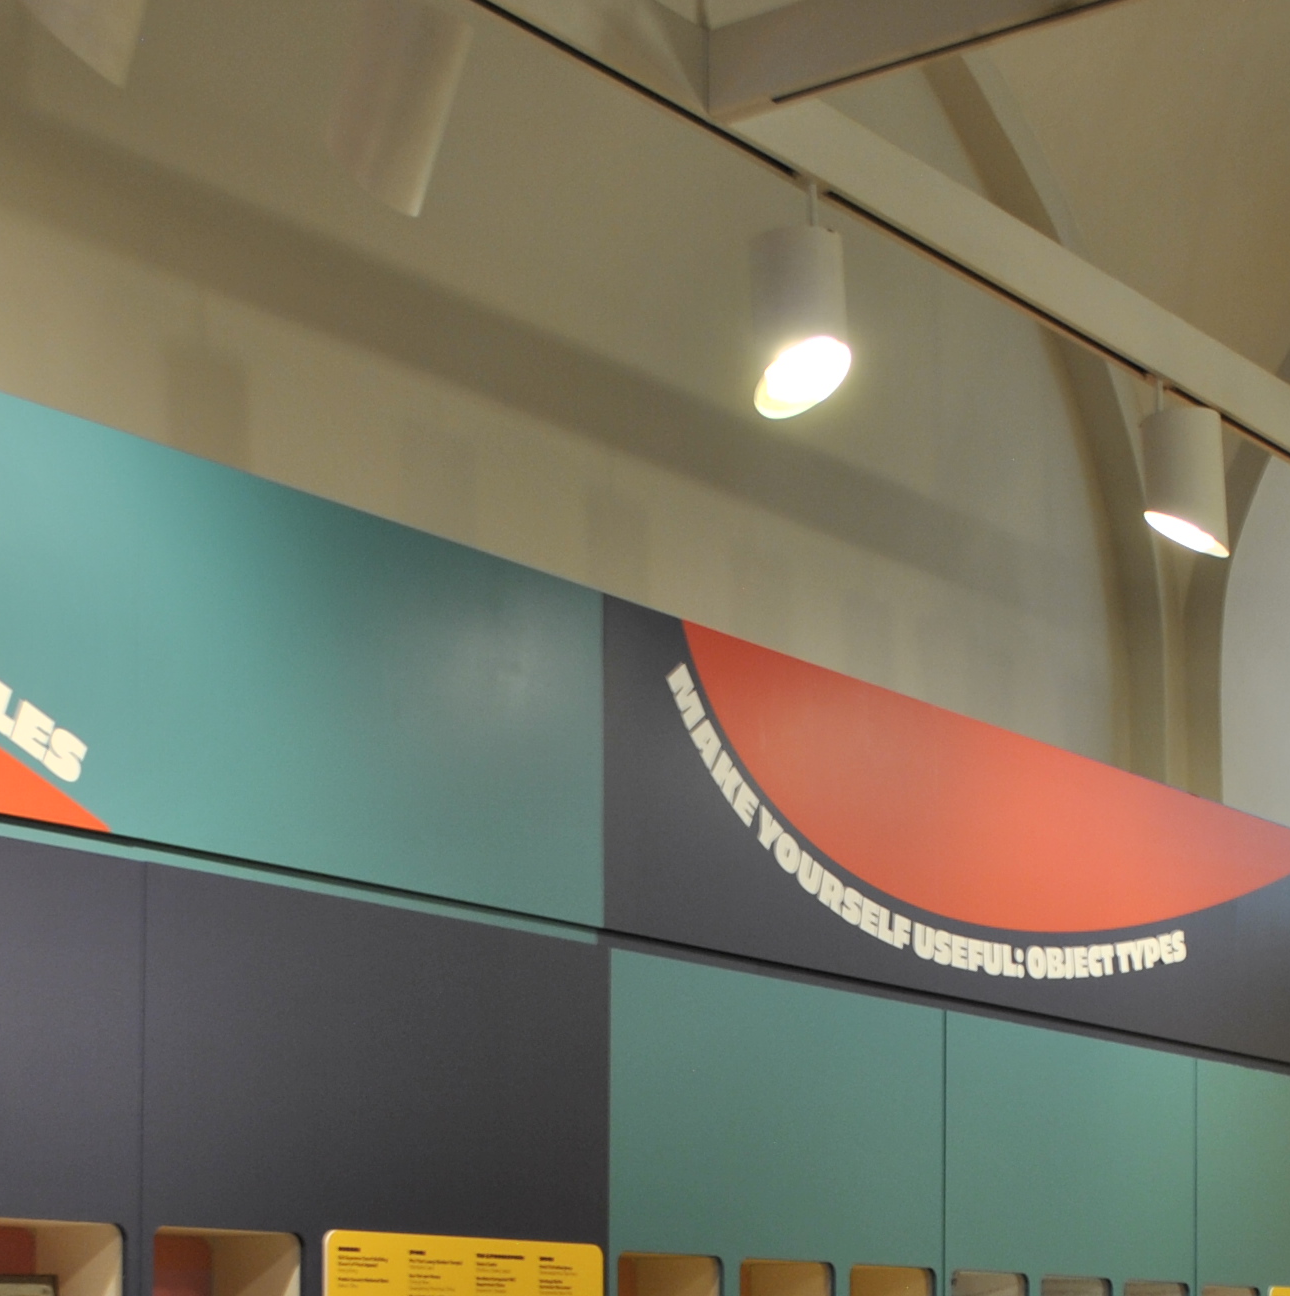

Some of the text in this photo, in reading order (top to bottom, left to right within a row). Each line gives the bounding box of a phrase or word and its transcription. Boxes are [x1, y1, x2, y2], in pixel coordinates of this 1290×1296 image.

[665, 661, 1188, 980] MAKE YOURSELF USEFUL: OBJECT TYPES
